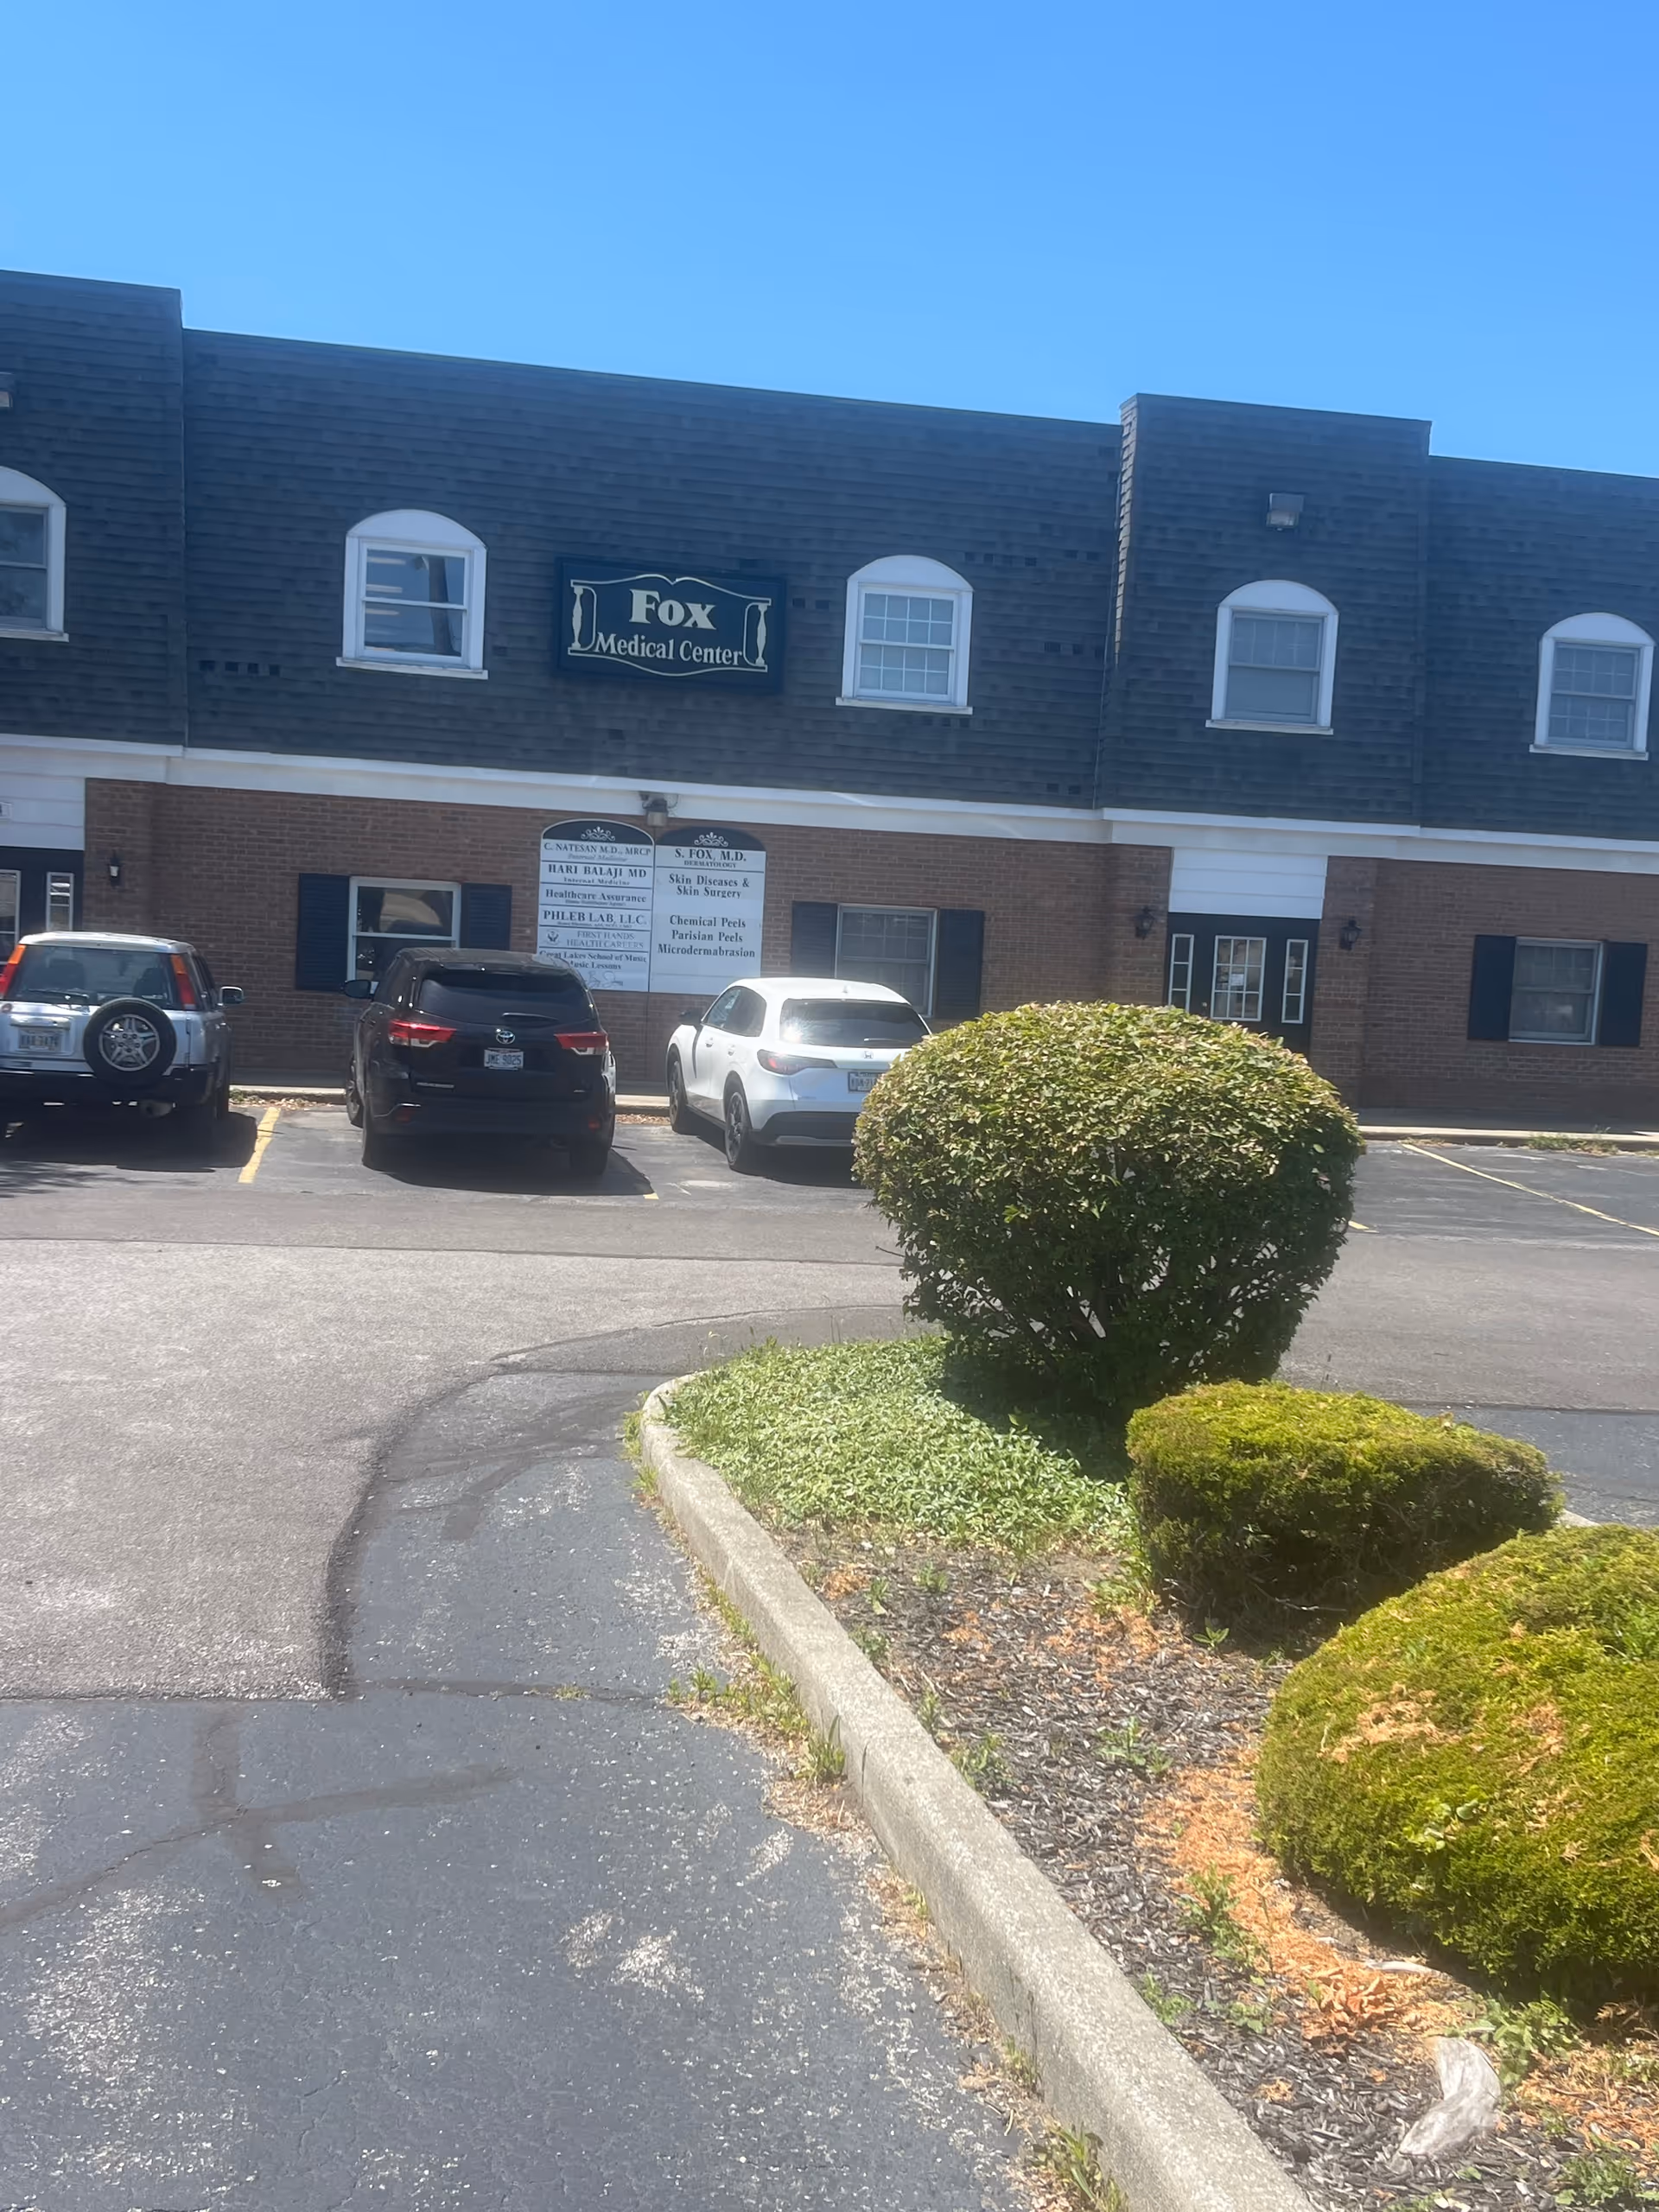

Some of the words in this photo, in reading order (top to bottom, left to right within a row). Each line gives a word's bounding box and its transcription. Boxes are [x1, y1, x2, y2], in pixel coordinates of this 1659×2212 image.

[594, 632, 674, 660] Medical
[679, 640, 743, 665] Center
[556, 843, 596, 853] NATESAN
[625, 847, 651, 856] MRCP
[674, 848, 684, 858] S.
[689, 849, 716, 861] FOX,
[720, 851, 747, 862] M.D.
[683, 860, 737, 869] DERMATOLOGY
[548, 864, 578, 874] HARI
[583, 866, 622, 879] BALAJI
[628, 868, 646, 878] MD
[668, 874, 692, 885] Skin
[696, 874, 738, 887] Diseases
[742, 878, 750, 887] &
[545, 889, 597, 900] Healthcare
[600, 893, 646, 902] Assurance
[676, 886, 700, 896] Skin
[703, 887, 741, 899] Surgery
[543, 910, 585, 922] PHLEB
[670, 914, 717, 927] Chemical
[721, 917, 747, 928] Peels
[576, 931, 602, 939] FIRST
[604, 931, 635, 940] HANDS
[671, 929, 714, 942] Parisian
[718, 931, 743, 943] Peels
[563, 950, 587, 959] Lakes
[658, 944, 756, 958] Microdermabrasion
